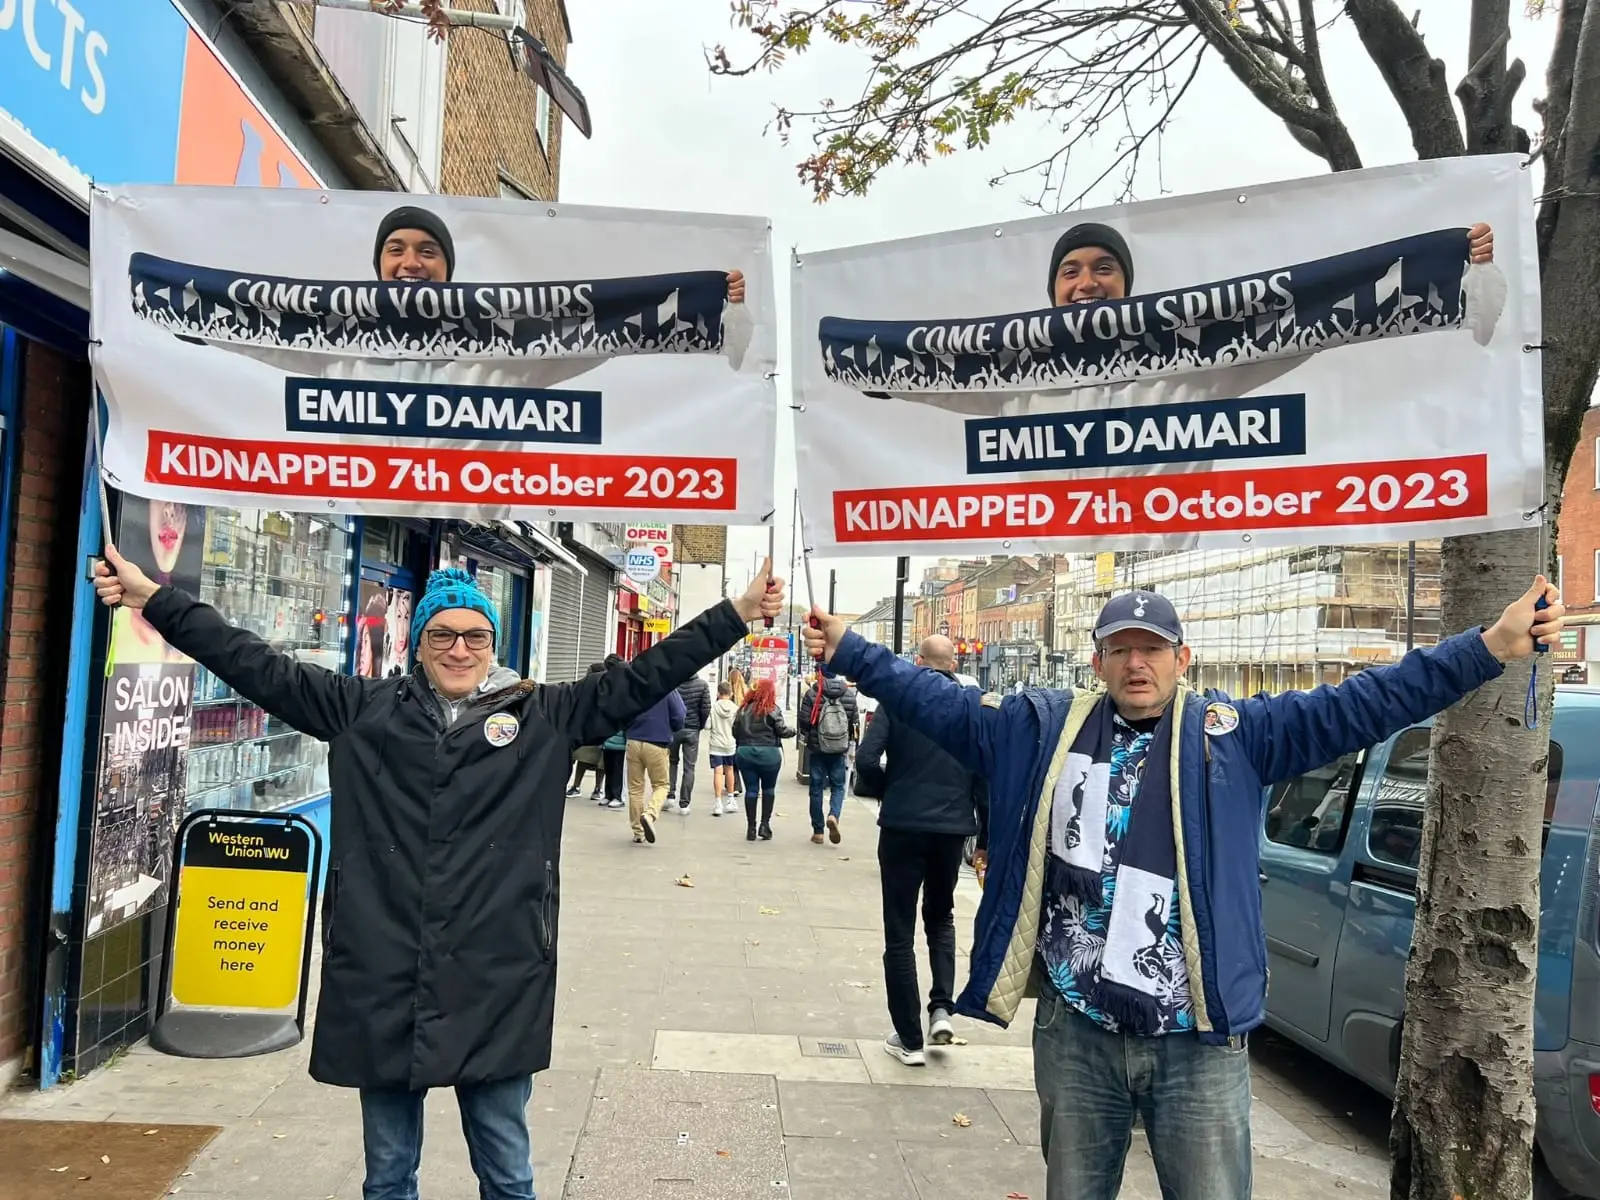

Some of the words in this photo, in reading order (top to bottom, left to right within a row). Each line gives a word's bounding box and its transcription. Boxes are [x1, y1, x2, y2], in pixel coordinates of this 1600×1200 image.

[0, 0, 108, 115] CTS
[227, 277, 323, 317] COME
[329, 285, 381, 320] ON
[387, 286, 467, 320] YOU
[473, 283, 595, 320] SPURS
[906, 321, 997, 356] COME
[1001, 314, 1055, 351] ON
[1061, 301, 1147, 344] YOU
[1158, 270, 1295, 333] SPURS
[298, 388, 417, 426] EMILY
[426, 394, 582, 433] DAMARI
[977, 421, 1096, 463] EMILY
[1104, 407, 1281, 455] DAMARI
[160, 442, 377, 488] KIDNAPPED
[387, 457, 450, 491] 7th
[459, 460, 614, 498] October
[623, 466, 725, 500] 2023
[844, 492, 1055, 532] KIDNAPPED
[1066, 488, 1132, 525] 7th
[1142, 481, 1323, 522] October
[1335, 469, 1470, 513] 2023
[627, 528, 668, 540] OPEN
[630, 555, 654, 566] NHS
[115, 676, 189, 711] SALON
[114, 715, 187, 755] INSIDE
[208, 831, 264, 846] Western
[225, 845, 263, 858] Union
[207, 896, 246, 910] Send
[249, 899, 279, 912] and
[213, 918, 269, 932] receive
[213, 940, 266, 955] money
[220, 958, 255, 972] here
